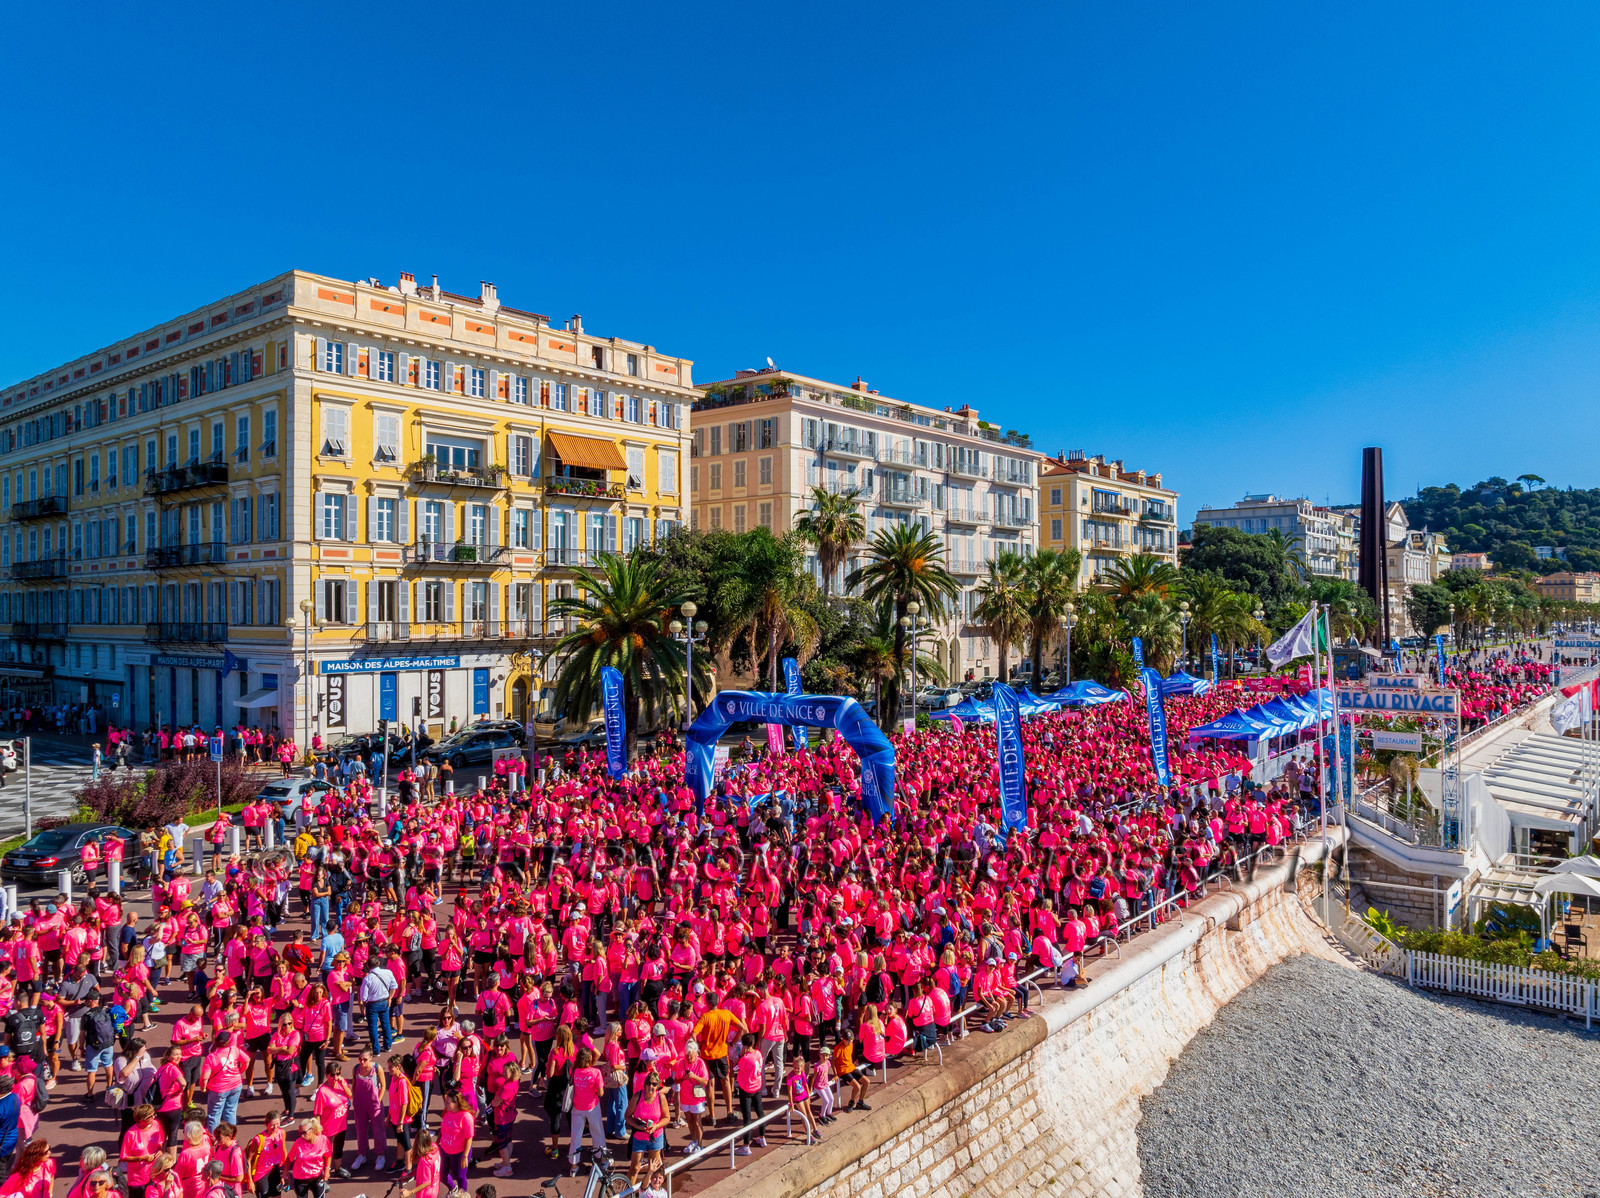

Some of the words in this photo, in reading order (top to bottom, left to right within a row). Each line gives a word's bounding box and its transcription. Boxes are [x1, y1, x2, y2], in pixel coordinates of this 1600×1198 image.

[157, 656, 177, 665] MAISON
[178, 657, 188, 665] DES
[327, 662, 363, 671] MAISON
[365, 661, 382, 669] DES
[384, 658, 456, 668] ALPES-MARITIMES
[1377, 677, 1414, 687] PLAGE
[329, 676, 342, 725] VOUS
[429, 672, 441, 717] VOUS
[608, 683, 619, 712] NICE
[1149, 684, 1161, 713] NICE
[1341, 692, 1386, 708] BEAU
[1391, 694, 1454, 712] RIVAGE
[608, 713, 620, 728] DE
[739, 701, 767, 717] VILLE
[769, 703, 784, 718] DE
[785, 704, 814, 720] NICE
[1001, 704, 1015, 741] NICE
[1152, 715, 1162, 732] DE
[610, 730, 622, 760] VILLE
[1155, 735, 1165, 767] VILLE
[1377, 737, 1417, 746] RESTAURANT
[1003, 744, 1018, 765] DE
[1005, 767, 1021, 807] VILLE
